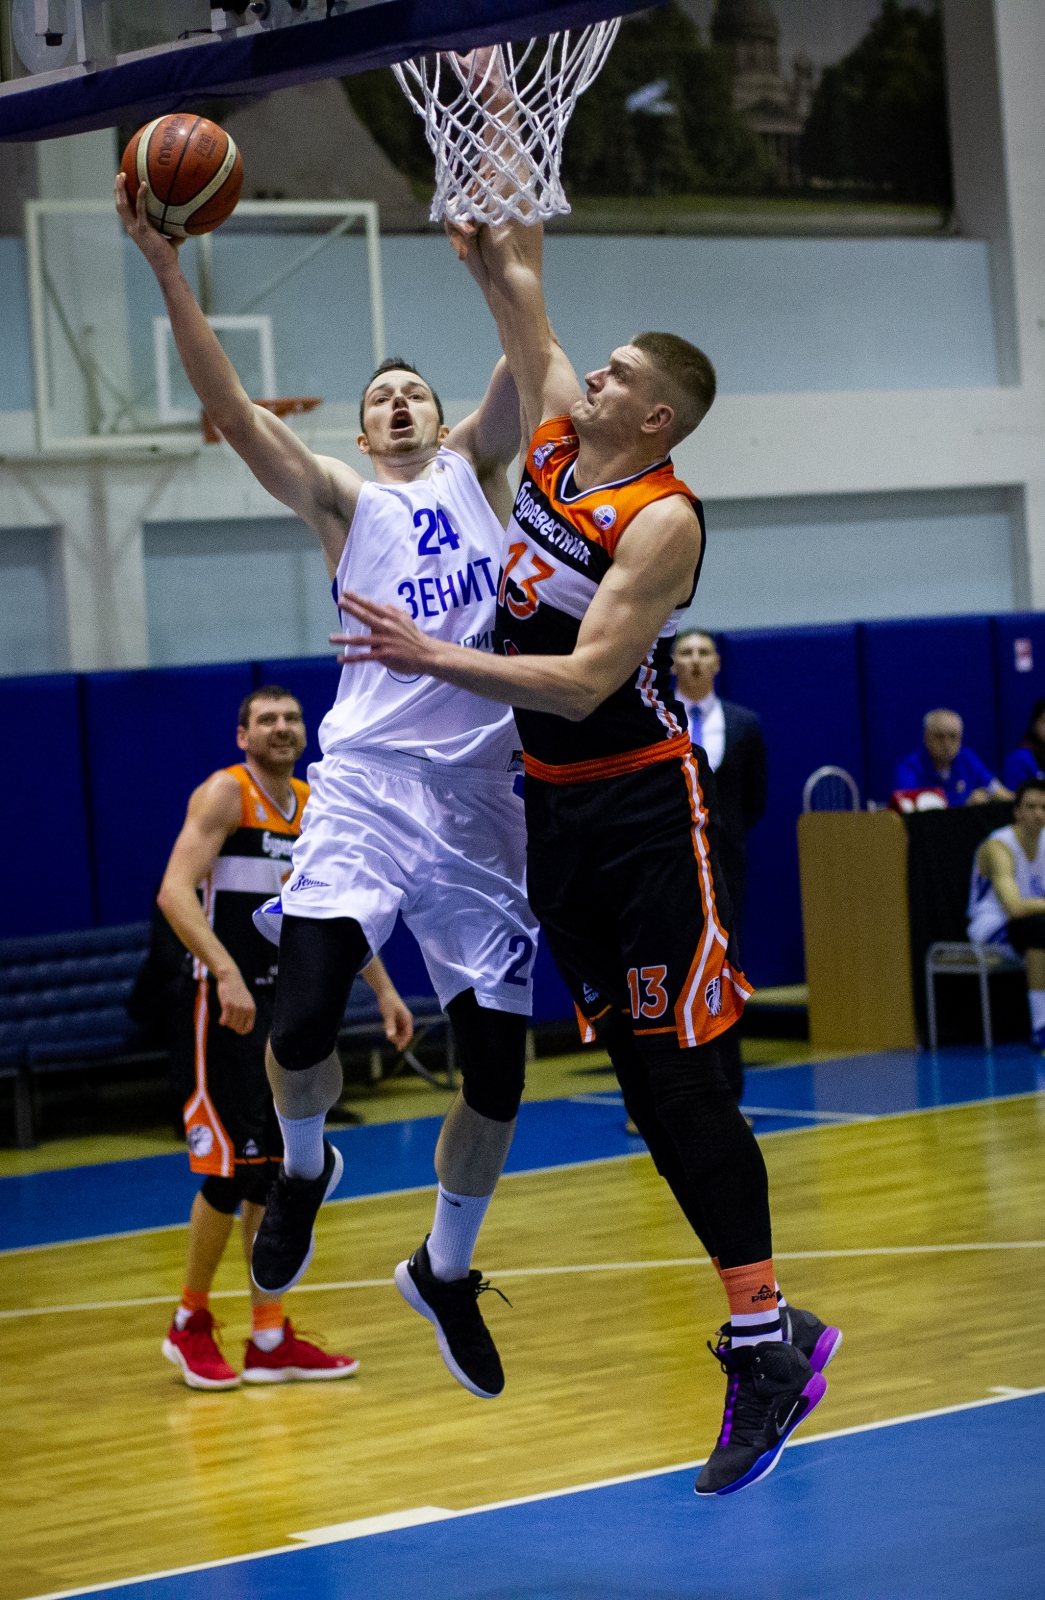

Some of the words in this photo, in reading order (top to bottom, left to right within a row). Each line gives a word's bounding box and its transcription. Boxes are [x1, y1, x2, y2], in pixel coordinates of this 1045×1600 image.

[413, 508, 460, 556] 24
[398, 557, 496, 620] ЗЕНИТ
[498, 541, 555, 619] 13
[627, 964, 668, 1019] 13
[752, 1291, 775, 1302] PEAK
